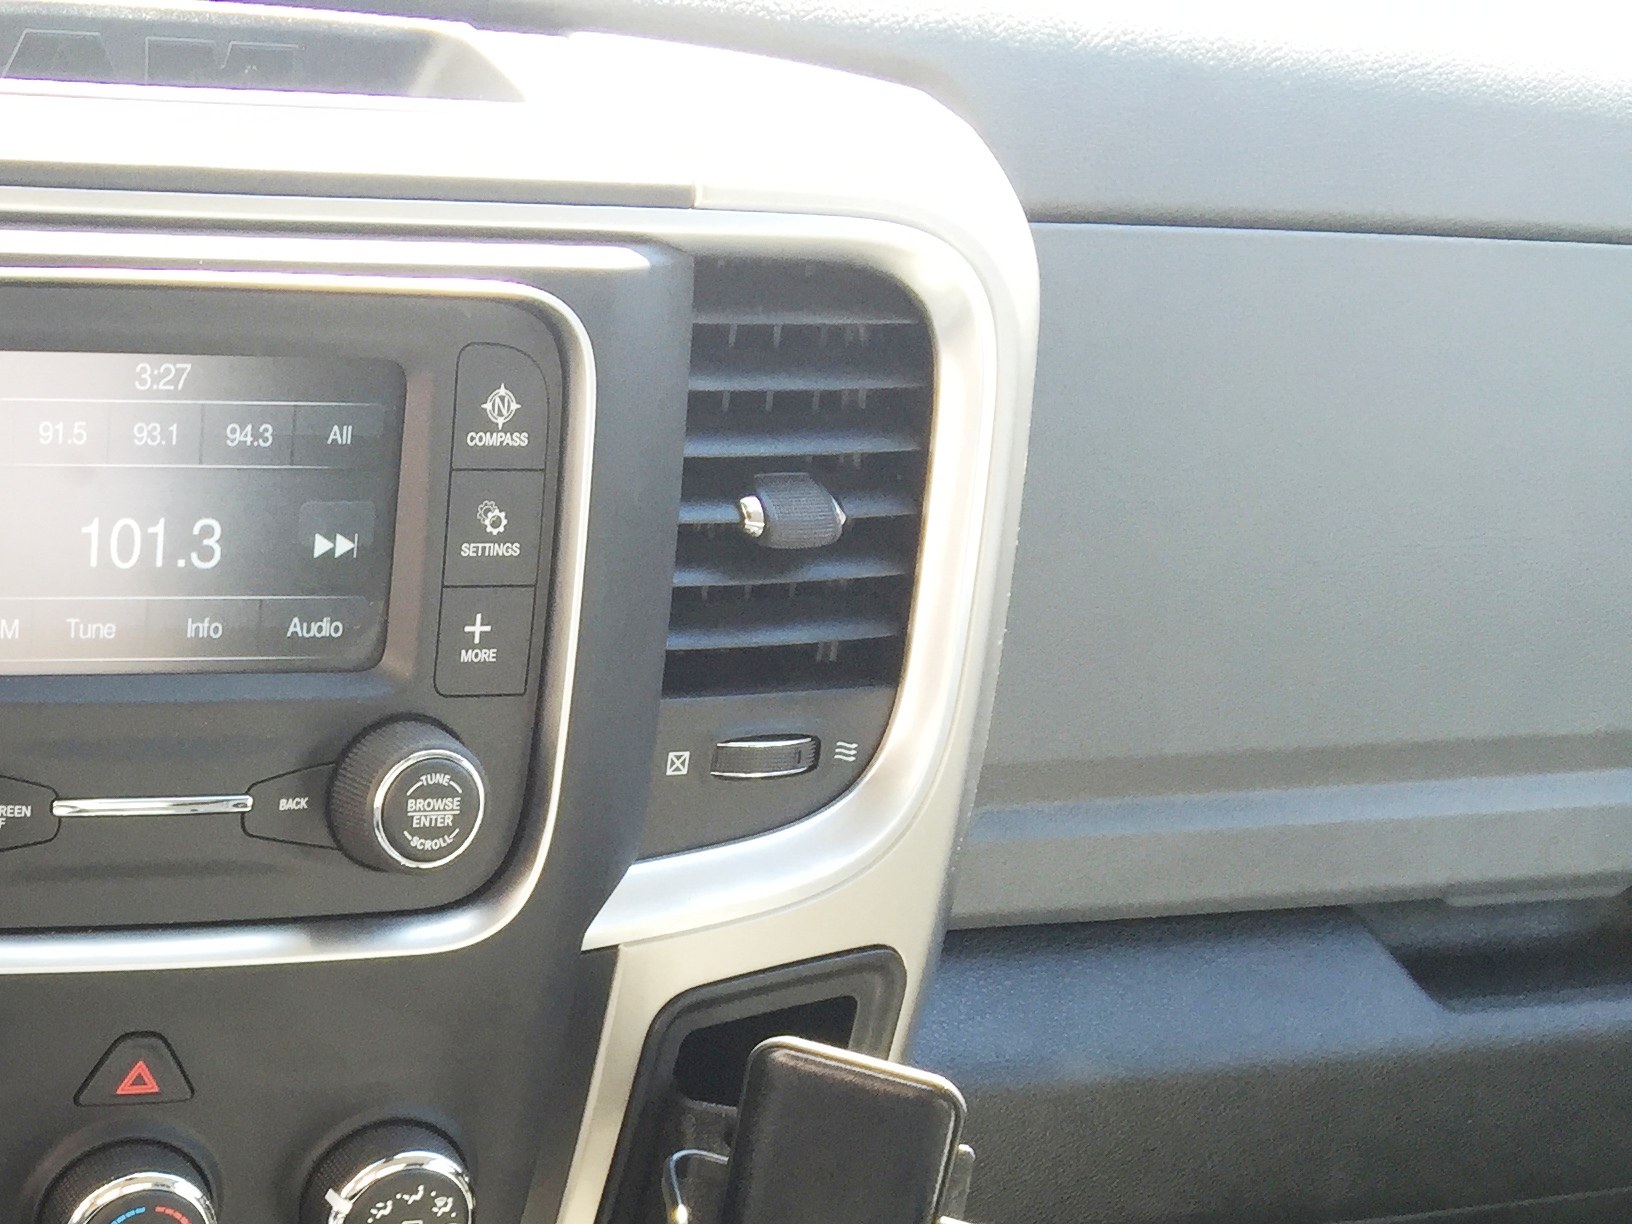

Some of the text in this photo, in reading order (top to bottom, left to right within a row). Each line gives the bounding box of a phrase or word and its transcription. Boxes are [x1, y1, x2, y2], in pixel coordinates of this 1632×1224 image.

[134, 362, 192, 391] 3:27
[38, 421, 87, 445] 91.5
[133, 422, 178, 446] 93.1
[226, 423, 274, 447] 94.3
[327, 424, 353, 446] All
[466, 431, 529, 447] COMPASS
[81, 517, 222, 569] 101.3
[460, 543, 520, 557] SETTINGS
[67, 619, 116, 639] Tune
[186, 618, 223, 639] Info
[286, 616, 343, 639] Audio
[460, 649, 497, 662] MORE
[420, 773, 451, 787] TUNE
[279, 797, 308, 811] BACK
[407, 797, 461, 812] BROWSE
[412, 815, 453, 828] ENTER
[410, 835, 452, 851] SCROLL
